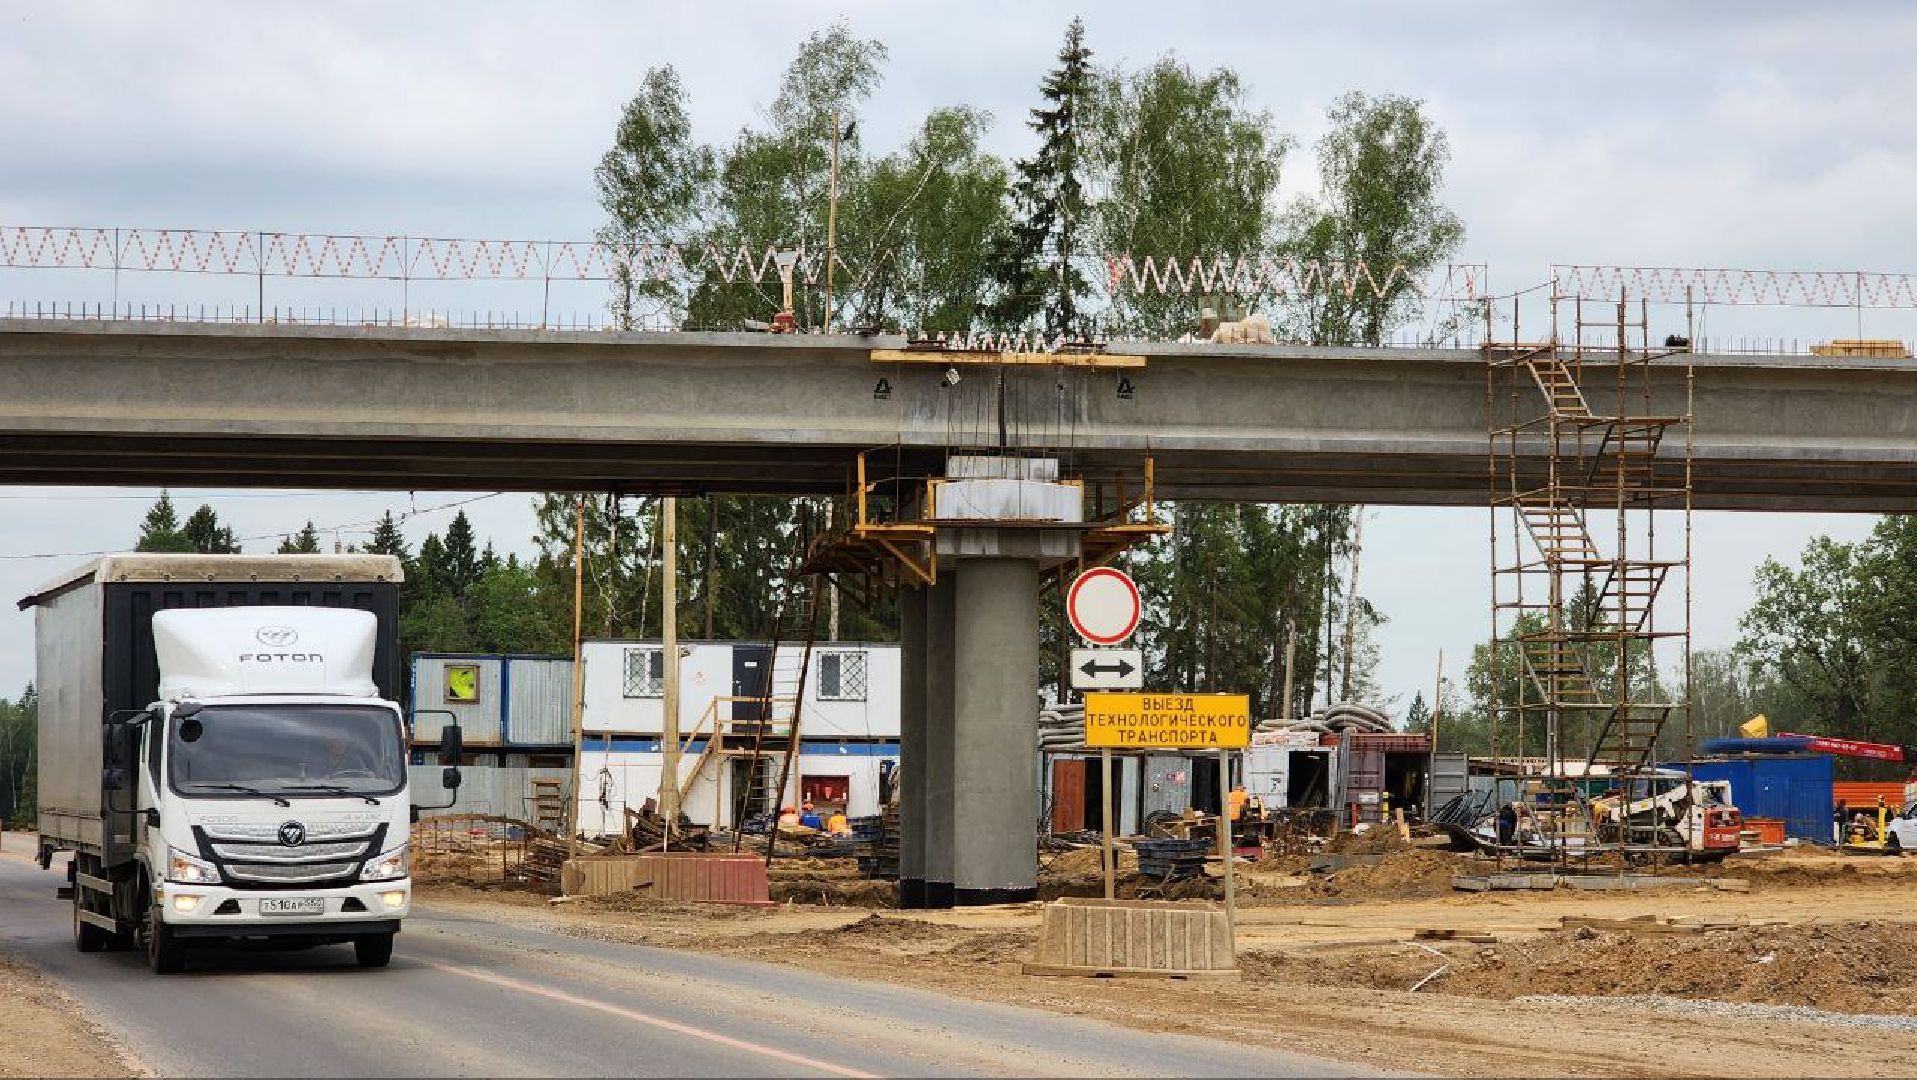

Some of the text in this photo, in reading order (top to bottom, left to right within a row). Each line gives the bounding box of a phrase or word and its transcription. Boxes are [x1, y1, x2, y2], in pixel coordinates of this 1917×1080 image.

[239, 653, 323, 662] FOTON
[1143, 698, 1194, 711] ВЫЕЗД
[1088, 714, 1246, 727] ТЕХНОЛОГИЧЕСКОГО
[1118, 730, 1217, 743] ТРАНСПОРТА
